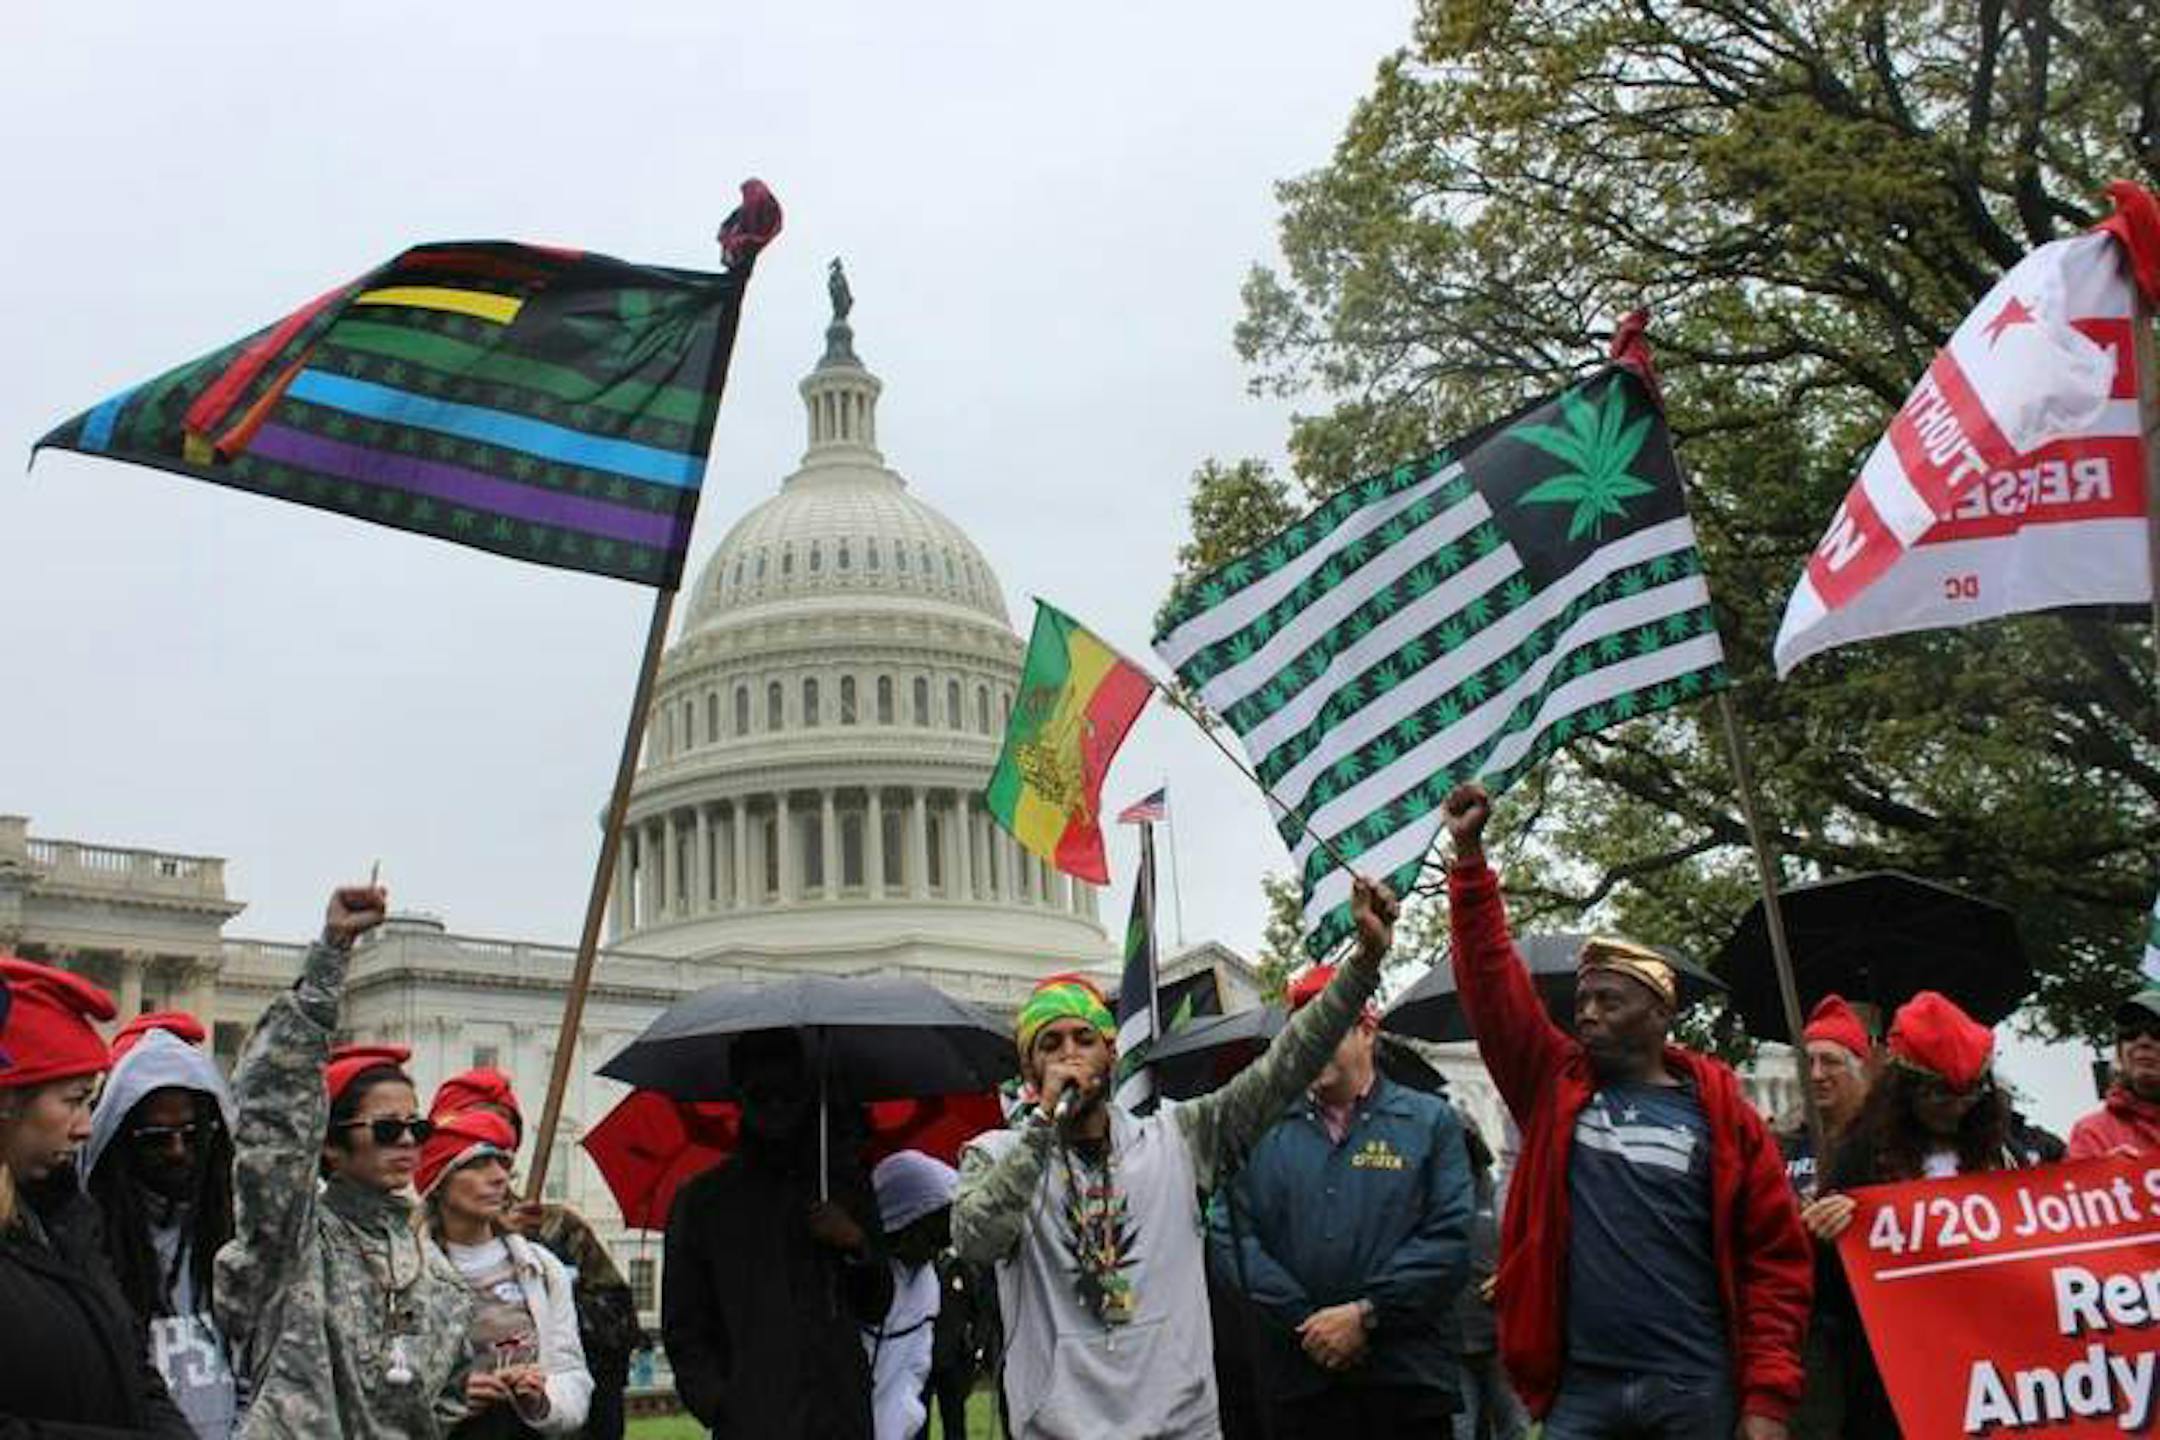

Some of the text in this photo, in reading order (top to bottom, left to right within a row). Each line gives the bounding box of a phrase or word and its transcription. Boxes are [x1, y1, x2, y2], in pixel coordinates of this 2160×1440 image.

[1869, 1194, 2000, 1254] 4/20
[2014, 1177, 2141, 1236] Joint
[1963, 1342, 2156, 1434] Andy
